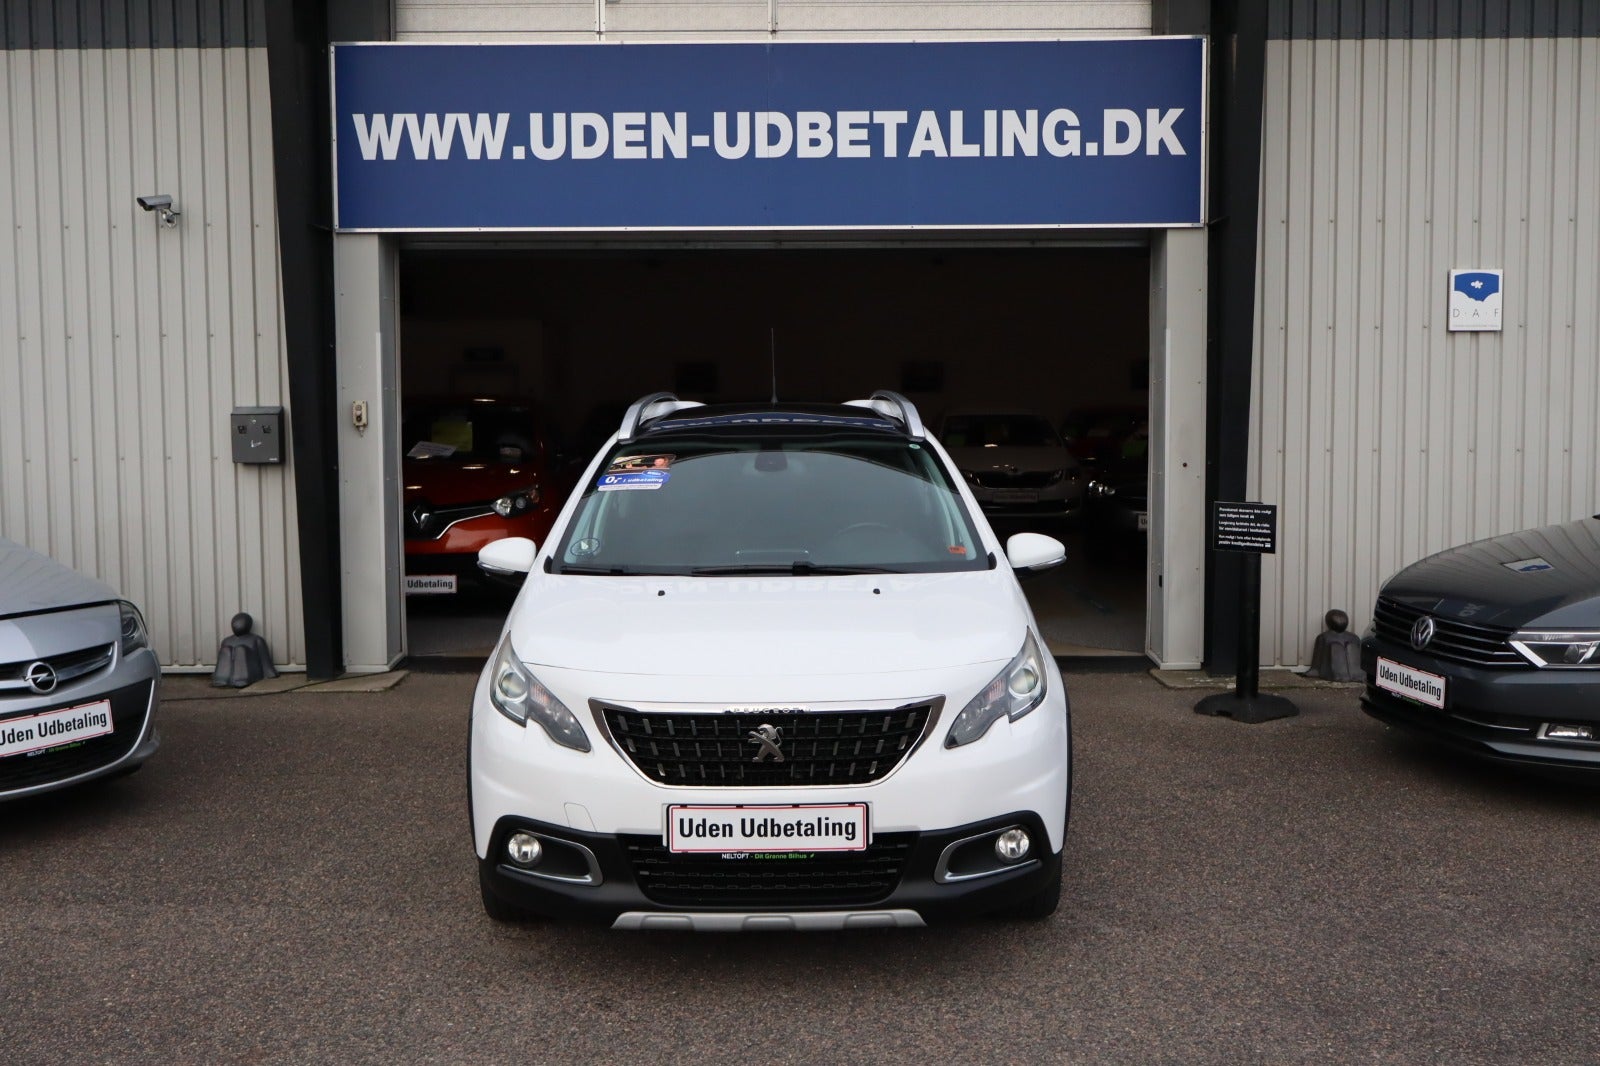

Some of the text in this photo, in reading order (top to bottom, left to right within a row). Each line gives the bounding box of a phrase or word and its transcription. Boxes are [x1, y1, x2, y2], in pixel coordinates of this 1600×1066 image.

[352, 107, 1187, 162] WWW.UDEN-UDBETALING.DK
[407, 579, 453, 590] Udbetaling
[1379, 664, 1398, 684] Uden
[1400, 672, 1442, 701] Udbetaling
[37, 712, 107, 738] Udbetaling
[679, 816, 856, 841] Uden Udbetaling
